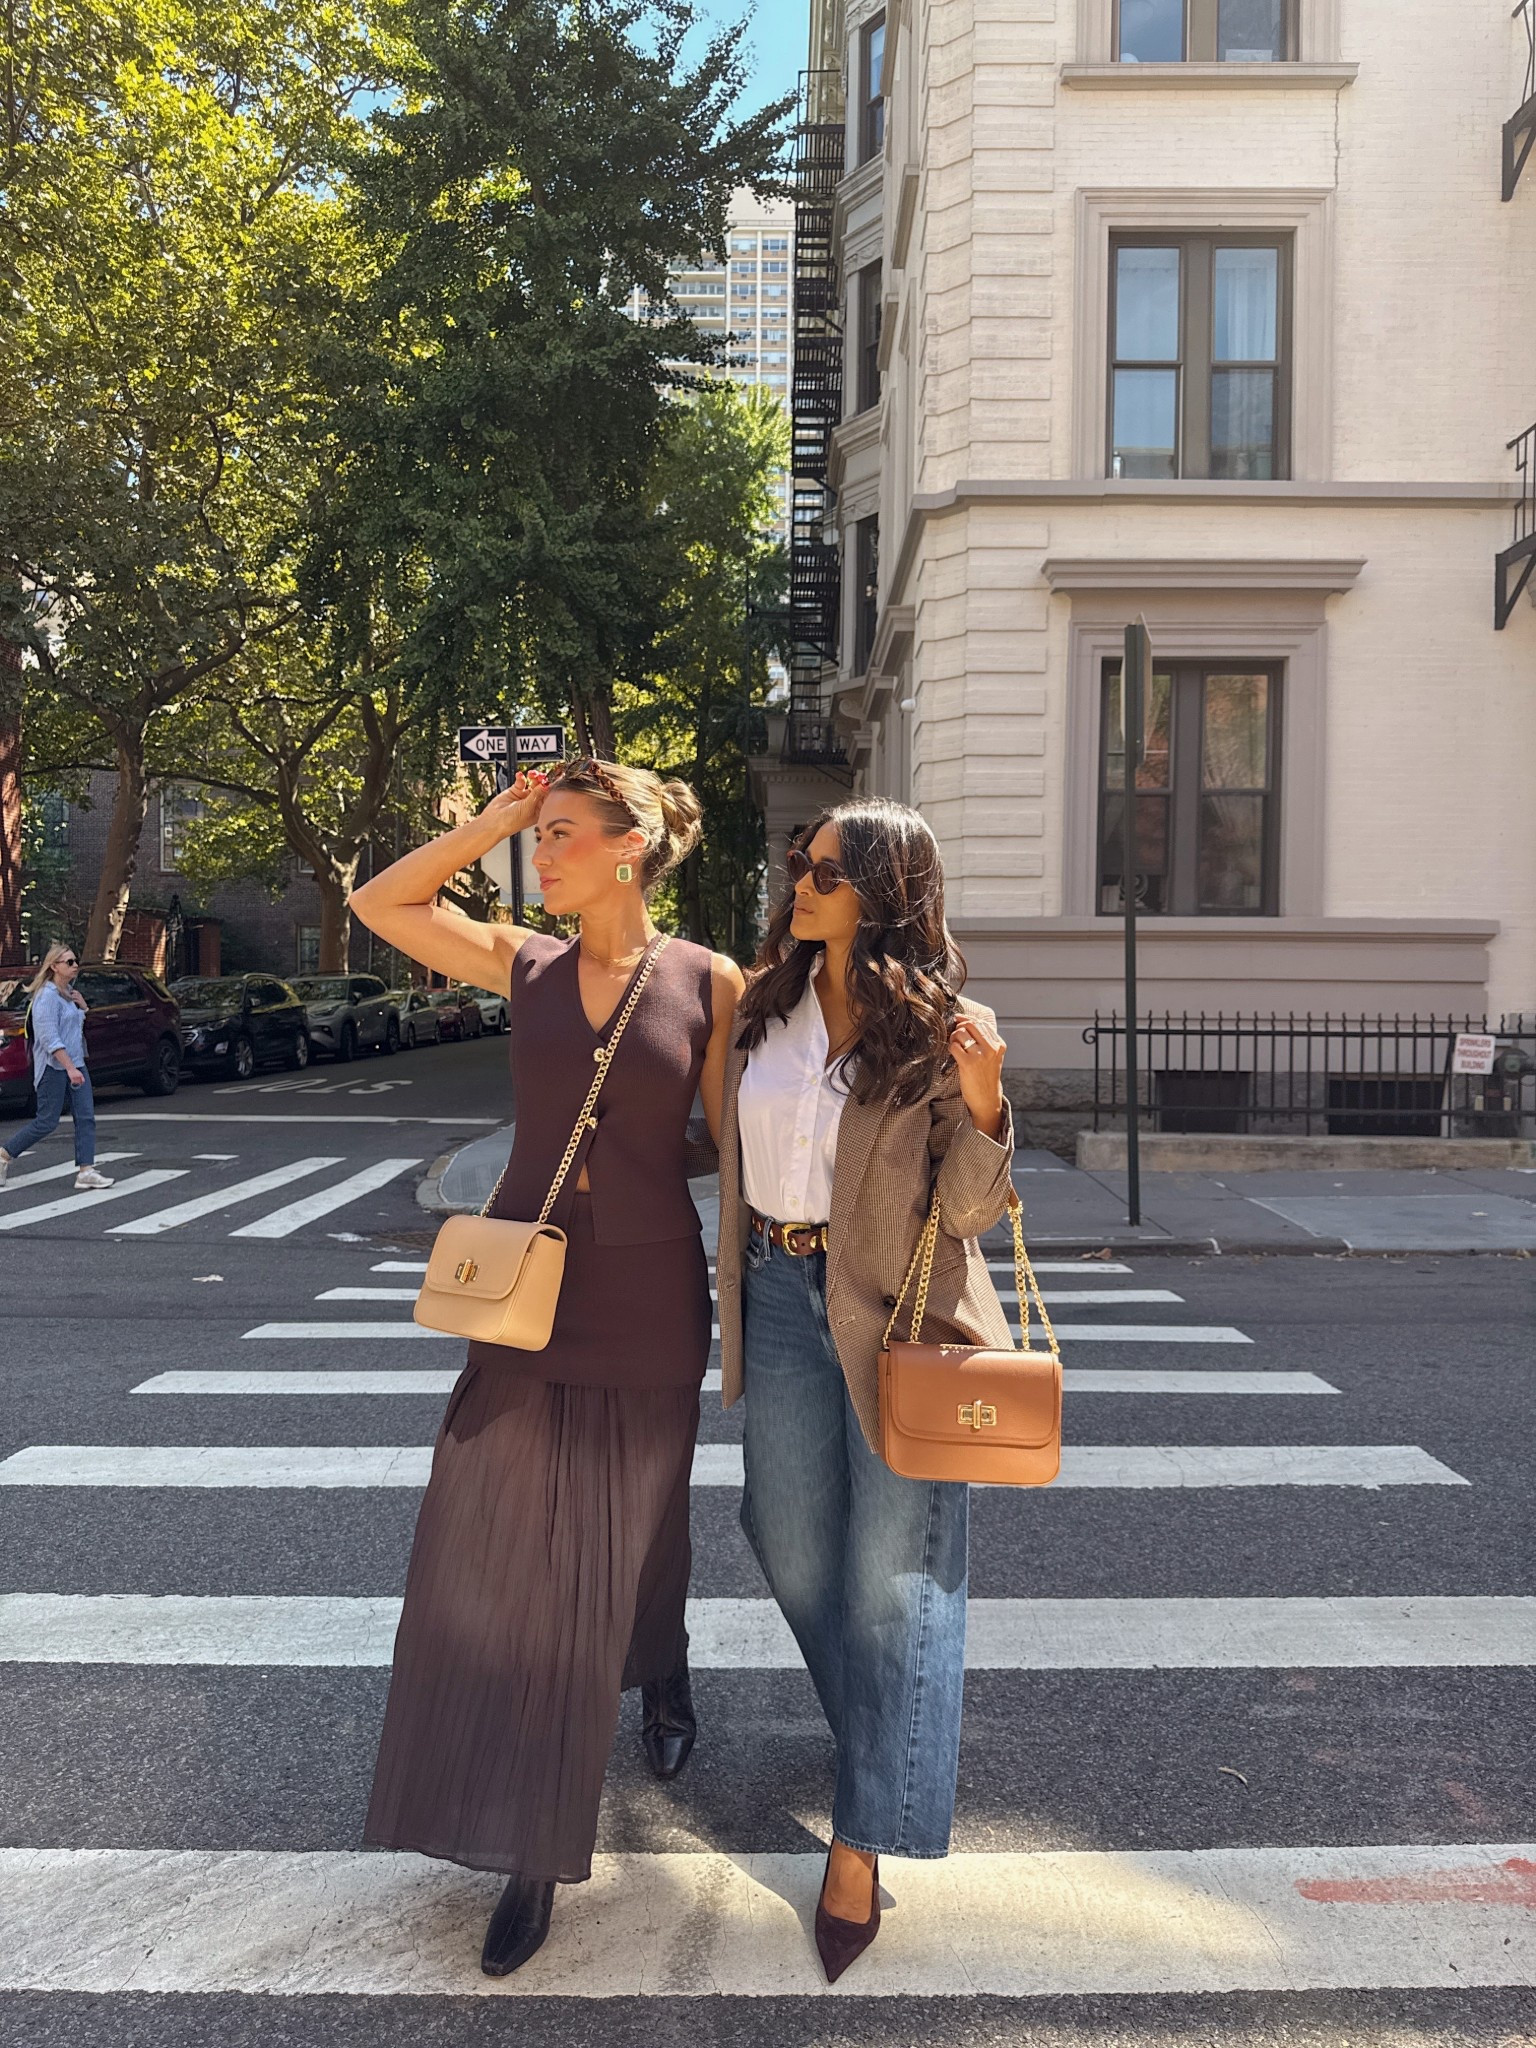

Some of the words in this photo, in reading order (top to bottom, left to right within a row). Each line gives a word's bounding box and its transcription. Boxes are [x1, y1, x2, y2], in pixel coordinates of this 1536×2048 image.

[476, 738, 505, 751] ONE
[519, 737, 550, 751] WAY
[212, 1078, 413, 1095] STOP
